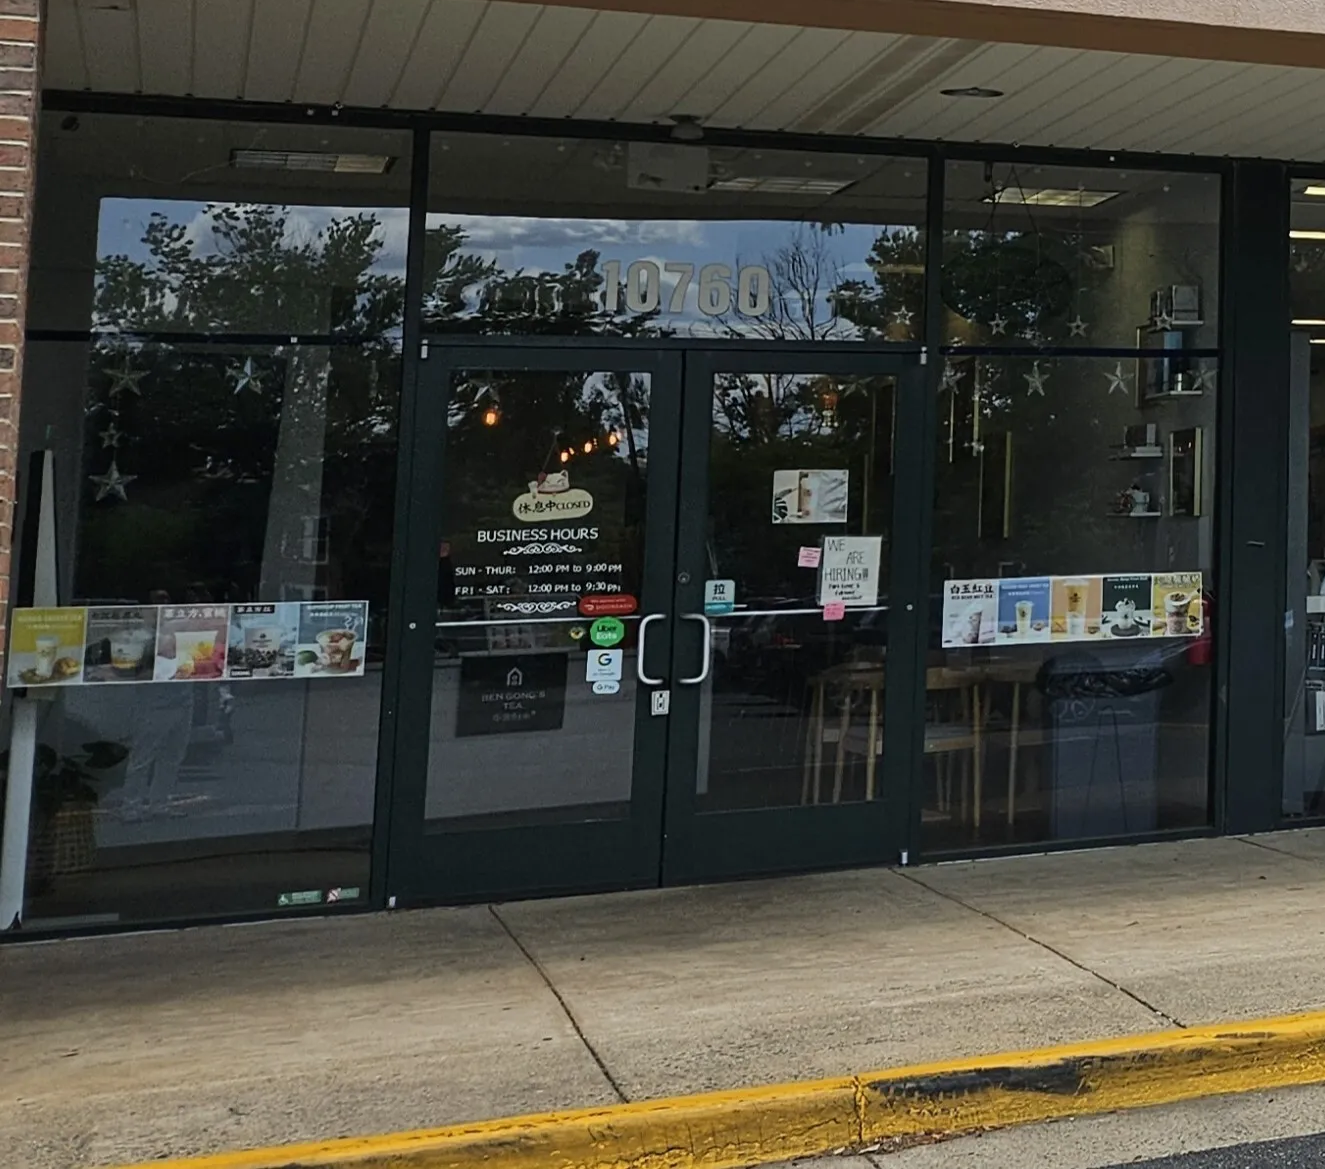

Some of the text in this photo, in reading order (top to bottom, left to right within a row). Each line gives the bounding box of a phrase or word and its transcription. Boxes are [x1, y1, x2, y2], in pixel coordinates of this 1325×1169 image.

[601, 260, 770, 317] 10760
[519, 501, 555, 514] 休息中
[556, 500, 591, 510] CLOSED
[477, 527, 599, 543] BUSINESS HOURS
[828, 538, 846, 552] WE
[846, 551, 866, 565] ARE
[455, 563, 622, 576] SUN THUR: 12:00 PM to 9:00 PM
[455, 587, 474, 595] FRI
[486, 585, 510, 595] SAT:
[528, 584, 552, 593] 12:00
[554, 584, 569, 593] PM
[571, 583, 581, 592] to
[586, 582, 606, 592] 9:30
